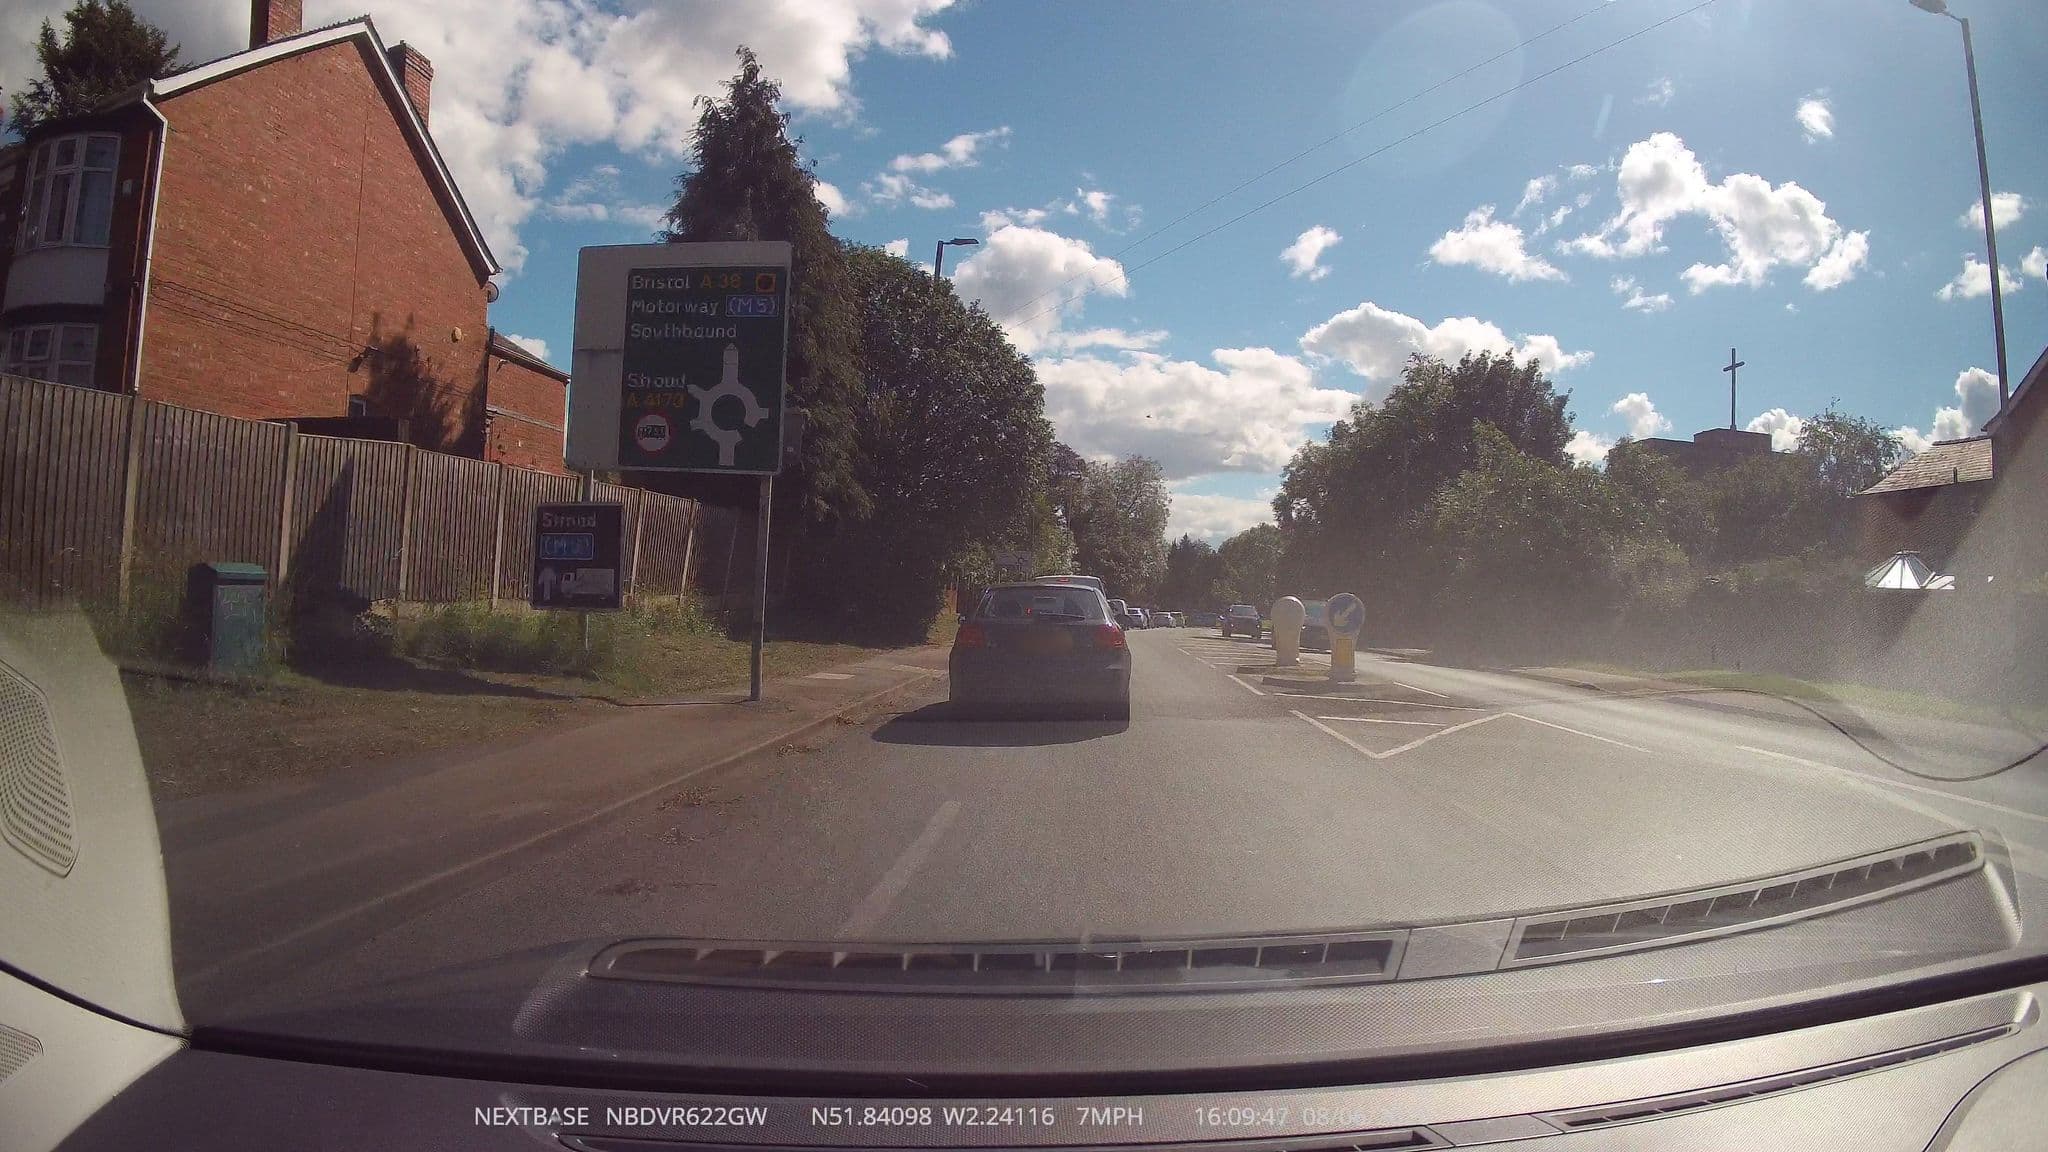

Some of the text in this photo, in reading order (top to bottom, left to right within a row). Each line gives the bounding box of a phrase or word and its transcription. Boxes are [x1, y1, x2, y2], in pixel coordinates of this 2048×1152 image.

[632, 274, 691, 289] Bristol
[631, 299, 719, 316] Motorway
[631, 323, 737, 339] Southbound
[627, 372, 686, 388] Stroud
